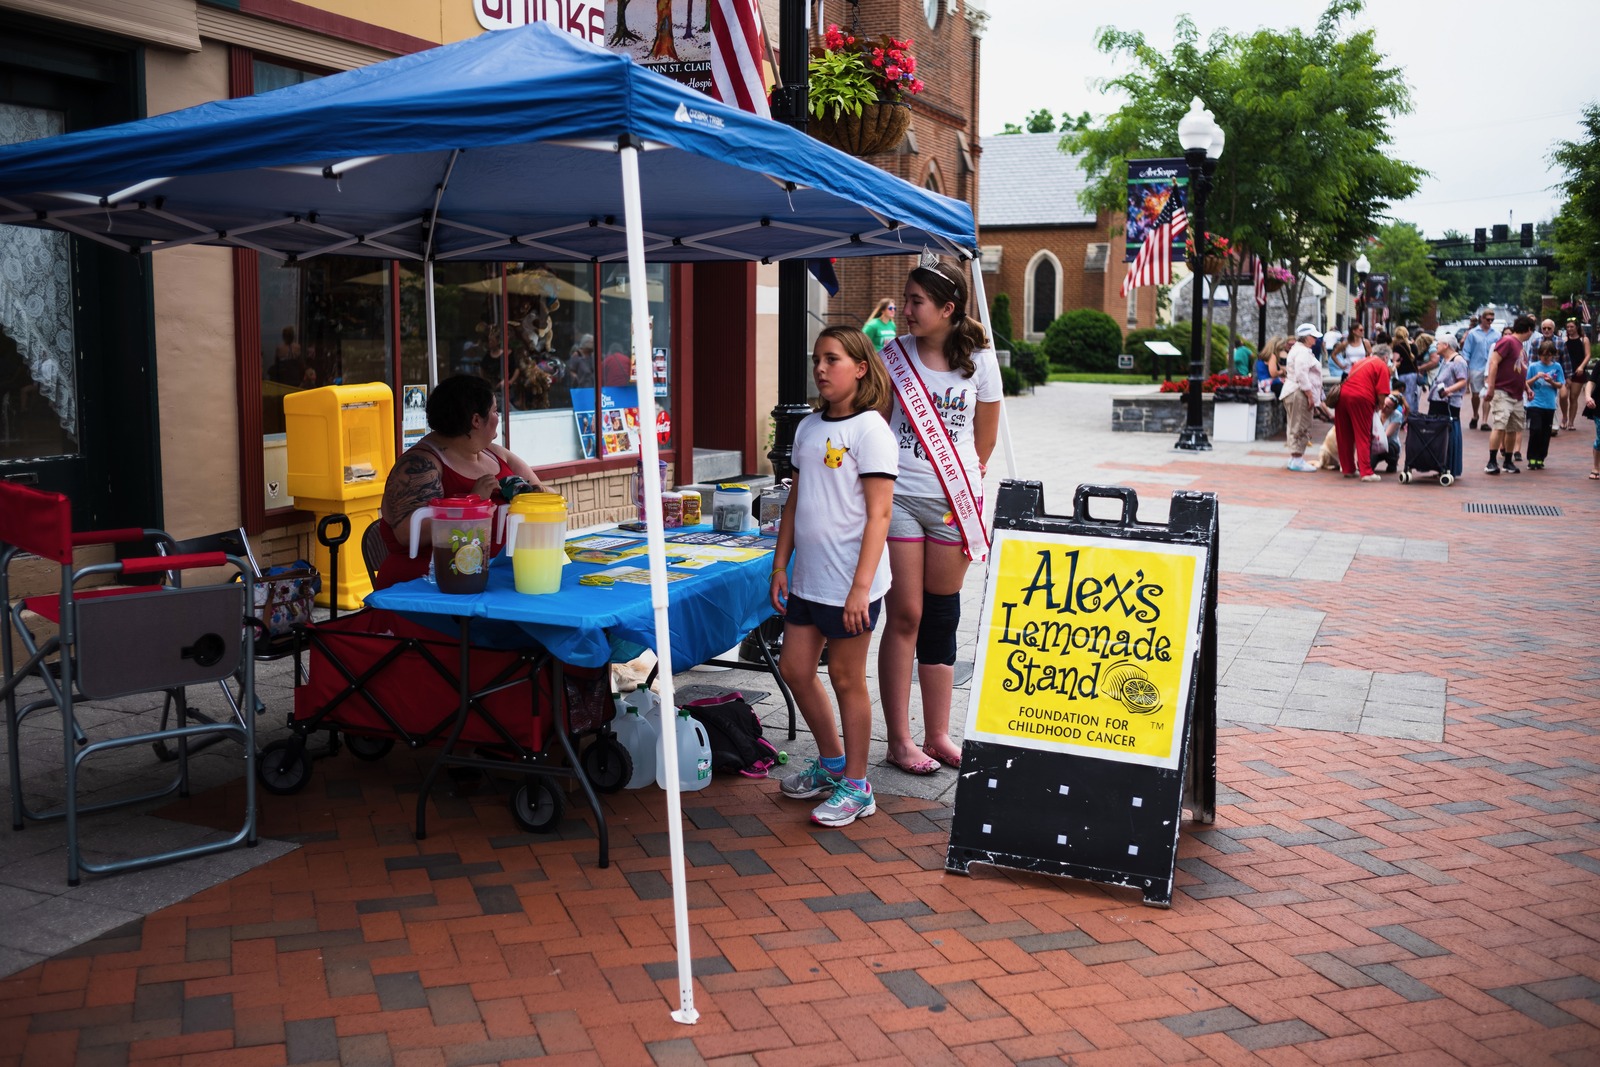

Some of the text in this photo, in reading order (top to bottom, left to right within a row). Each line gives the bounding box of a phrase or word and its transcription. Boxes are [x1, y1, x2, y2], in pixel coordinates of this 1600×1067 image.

[669, 63, 682, 73] ST.
[684, 62, 712, 72] CLAIR
[882, 344, 899, 365] MISS
[893, 364, 906, 378] VA
[900, 377, 928, 419] PRETEEN
[922, 419, 959, 482] SWEETHEART
[954, 489, 974, 520] NATIONAL TEENAGER
[1020, 550, 1164, 623] Alex's
[998, 602, 1172, 662] Lemonade
[1002, 649, 1101, 700] Stand
[1008, 719, 1136, 747] CHILDHOOD CANCER
[1019, 706, 1129, 731] FOUNDATION FOR
[1150, 721, 1164, 730] TM
